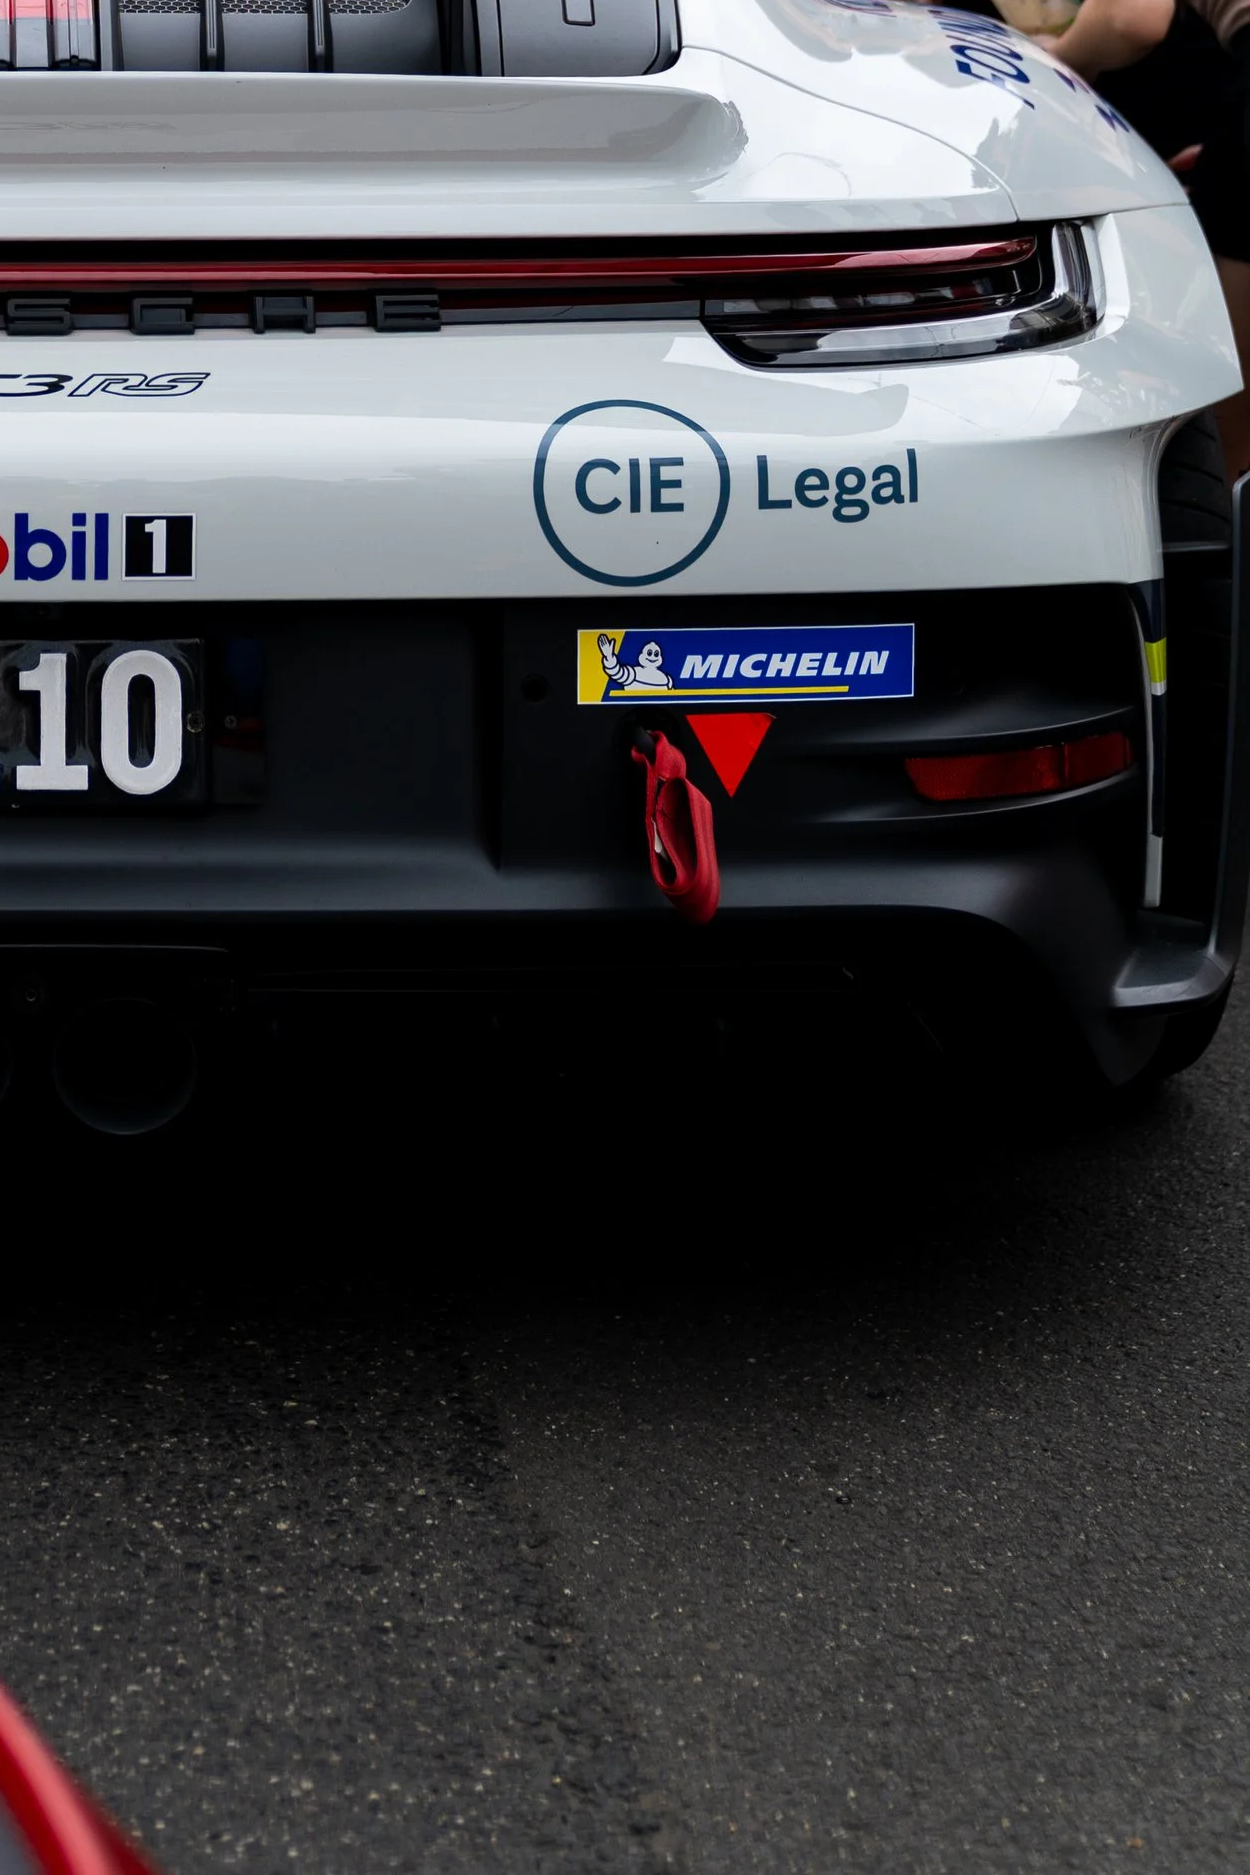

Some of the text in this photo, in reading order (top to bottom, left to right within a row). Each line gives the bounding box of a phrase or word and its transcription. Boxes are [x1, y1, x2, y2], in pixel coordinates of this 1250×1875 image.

[574, 447, 919, 523] CIE Legal
[679, 650, 890, 679] MICHELIN
